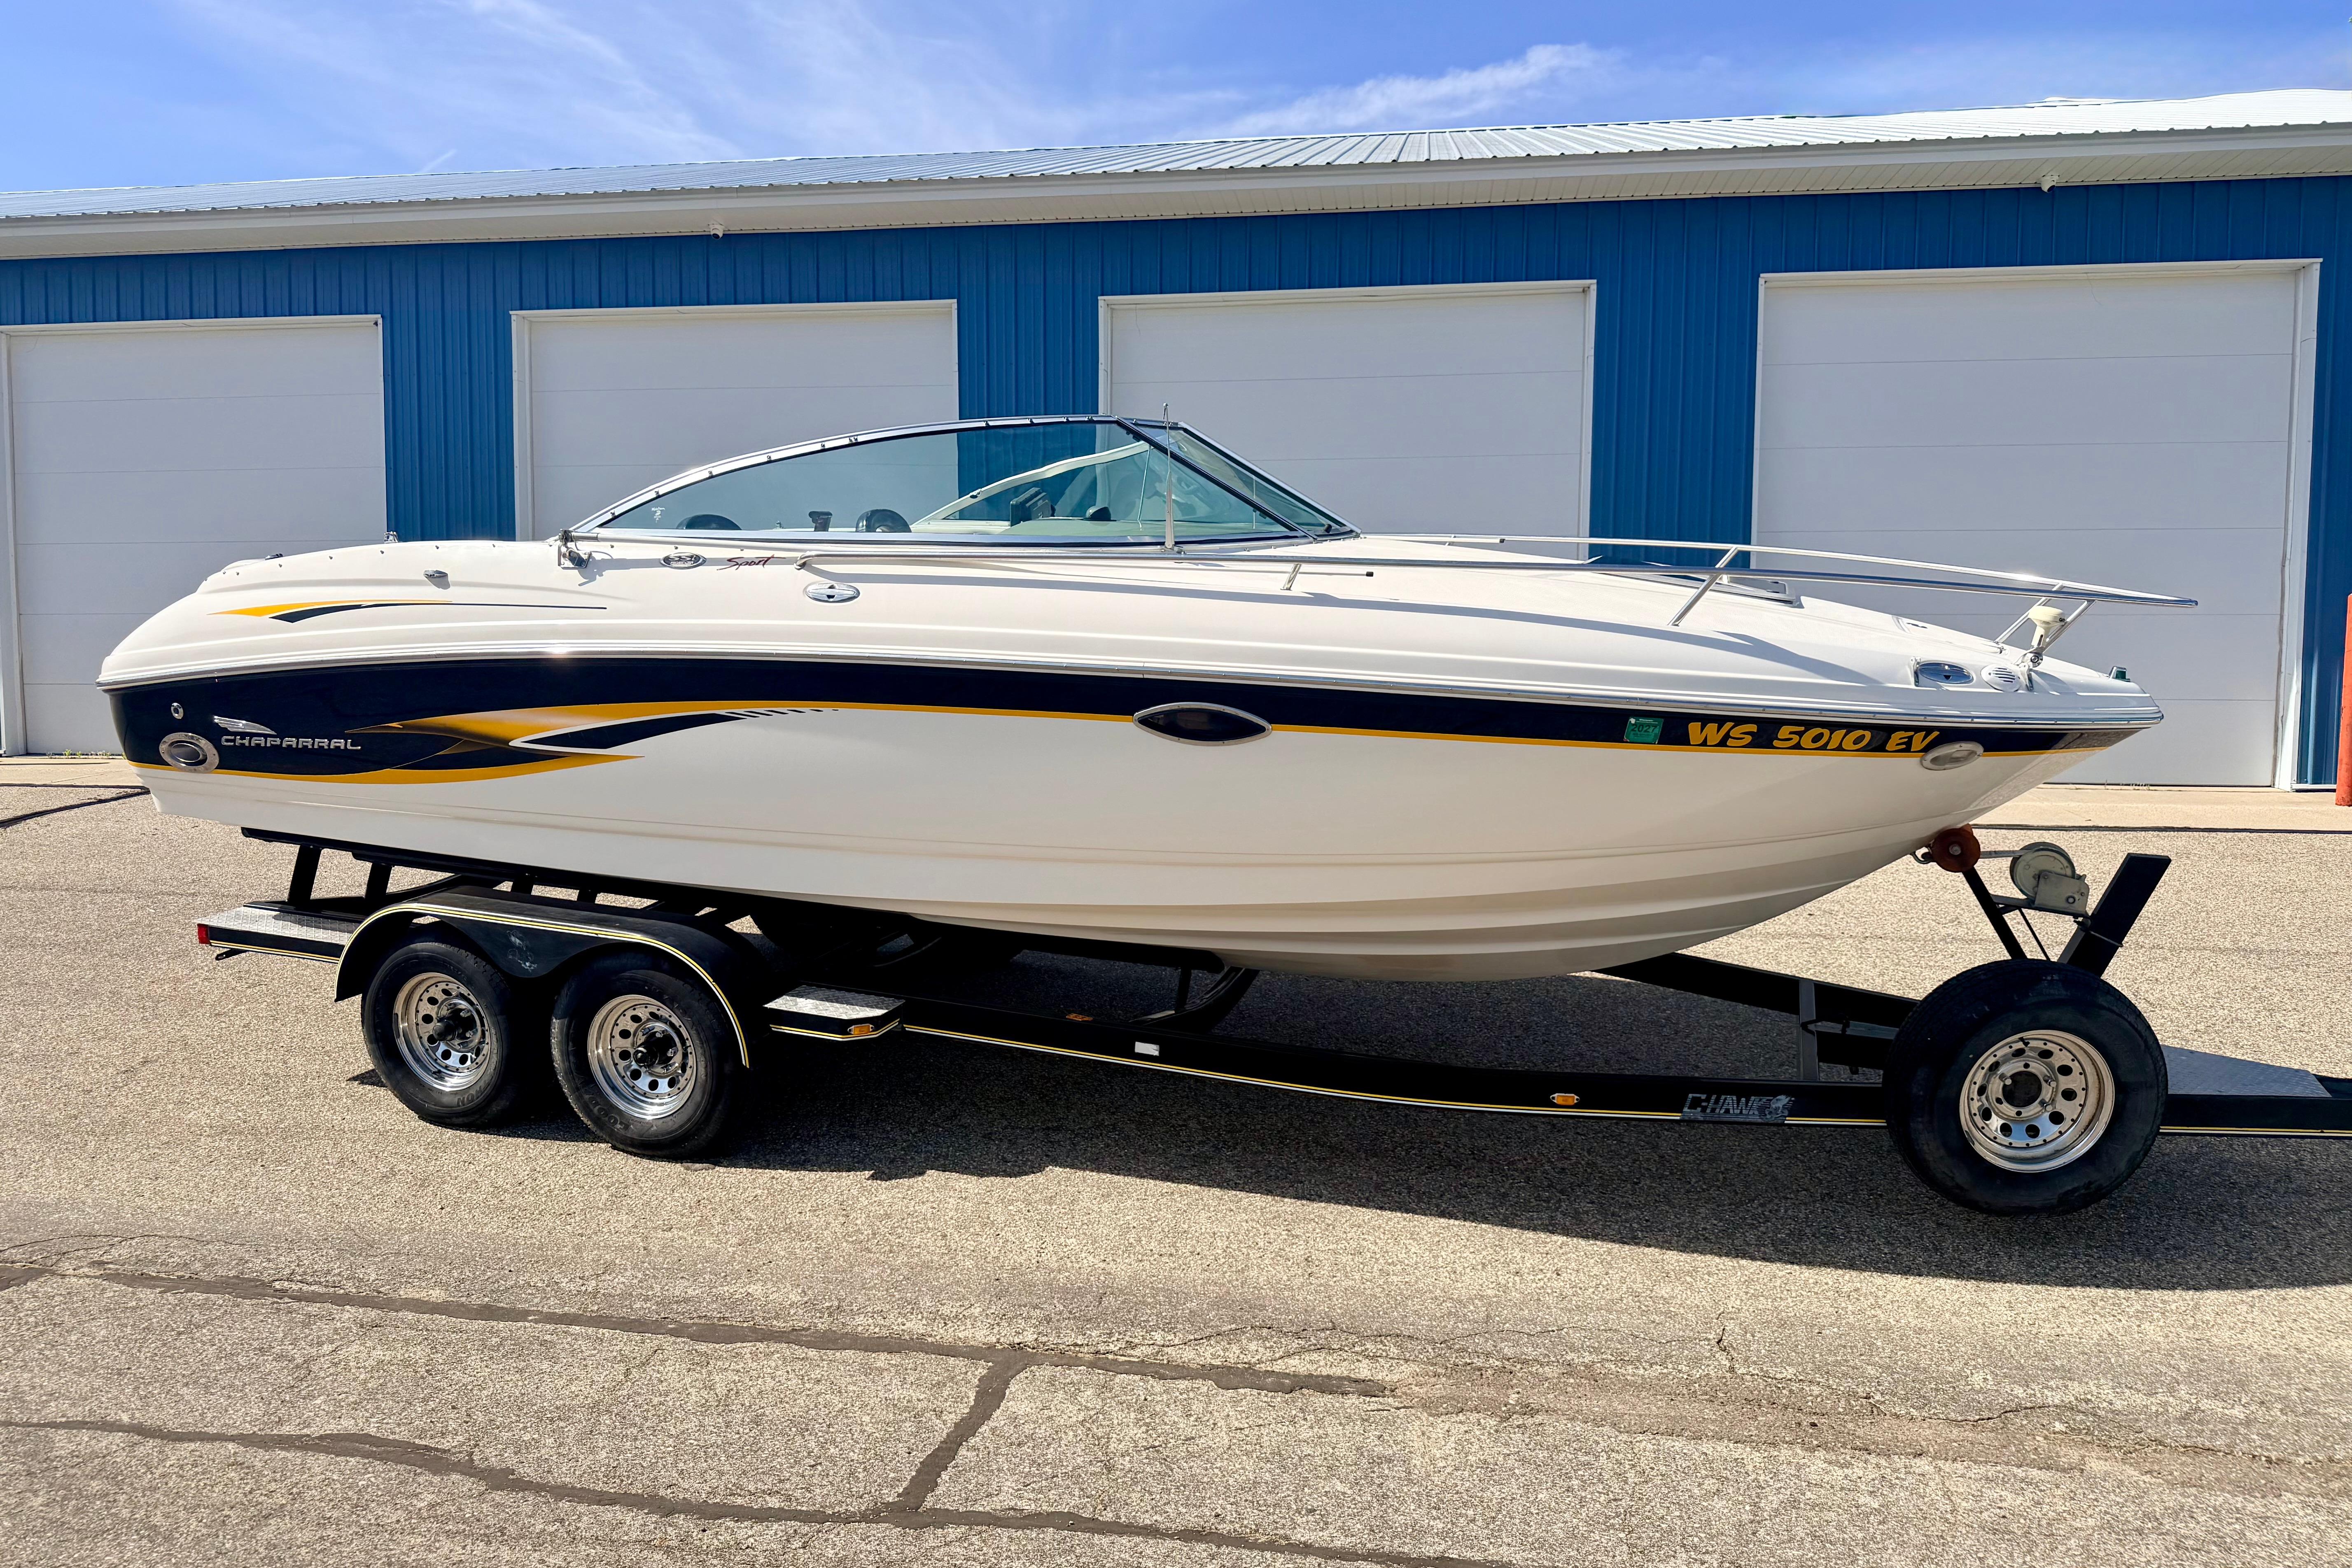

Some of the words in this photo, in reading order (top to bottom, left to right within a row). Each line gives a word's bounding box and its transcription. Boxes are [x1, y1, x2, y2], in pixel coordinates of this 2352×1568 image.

[716, 554, 786, 570] Sport
[1631, 724, 1657, 733] 2027
[221, 736, 361, 750] CHAPARRAL
[1688, 722, 1757, 747] WS
[1773, 726, 1871, 750] 5010
[1885, 731, 1940, 751] EV
